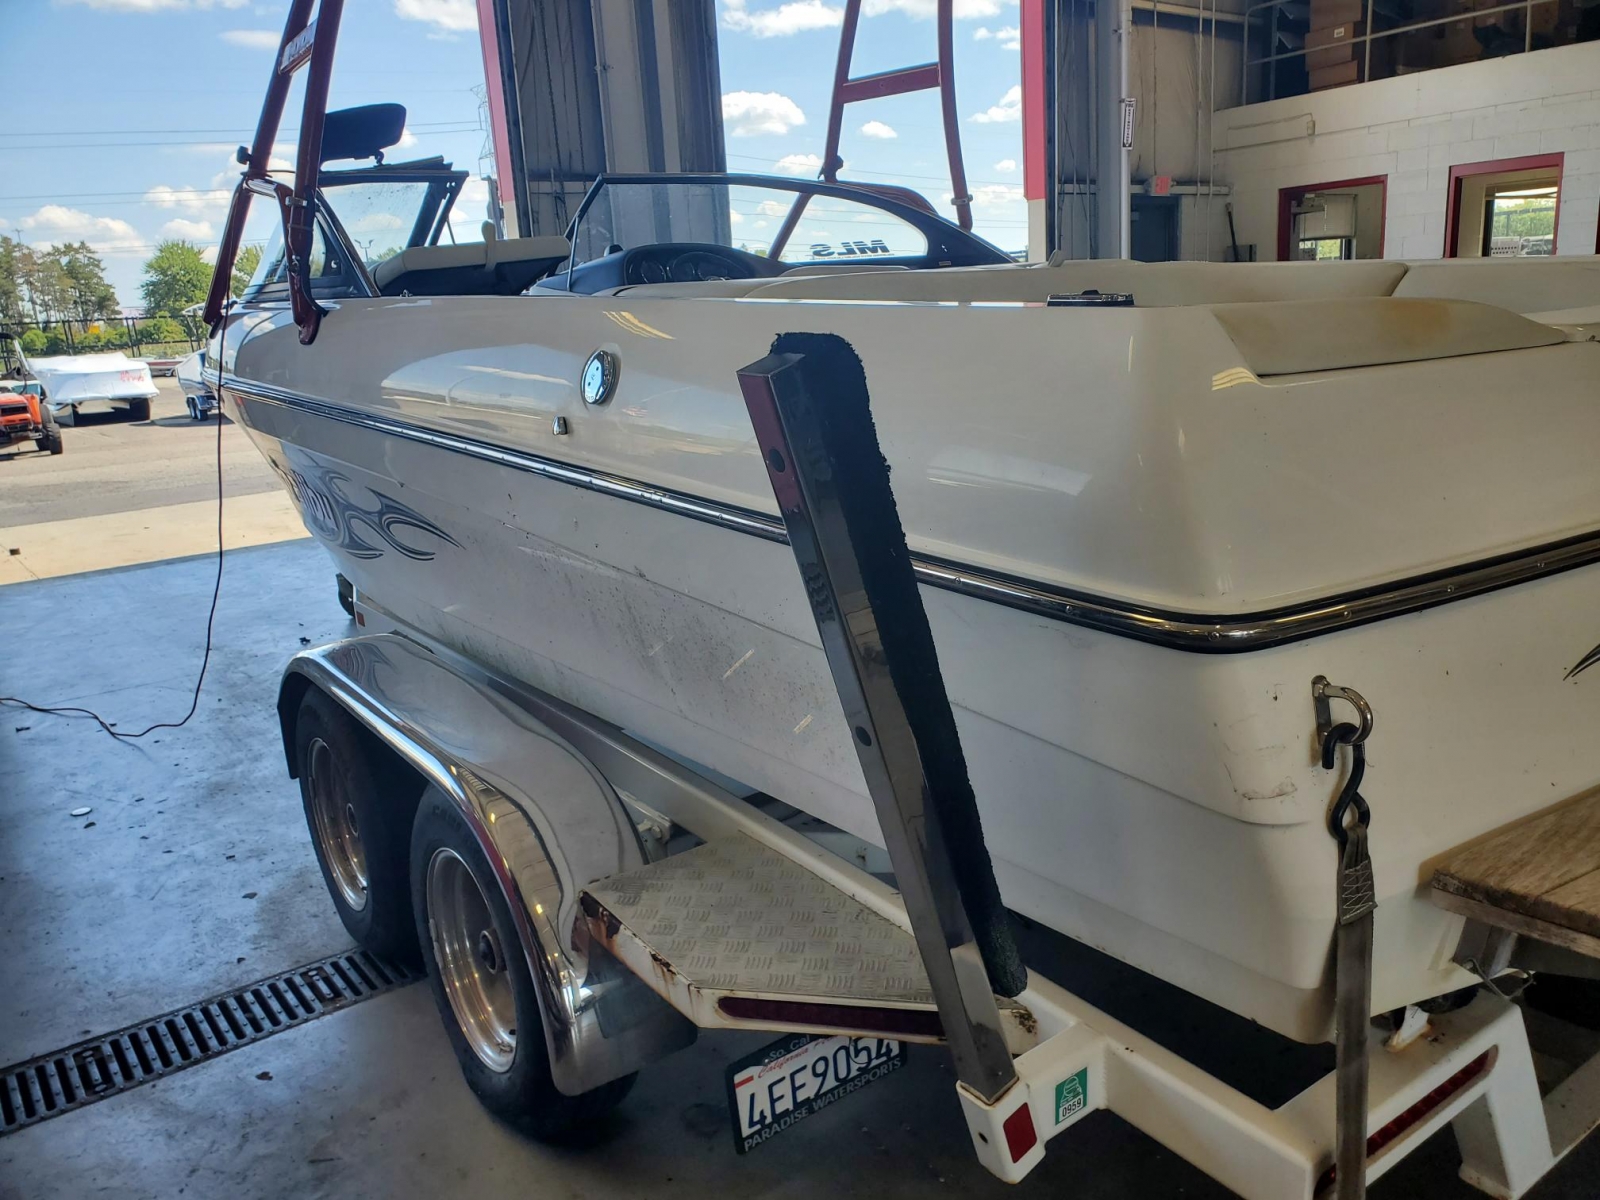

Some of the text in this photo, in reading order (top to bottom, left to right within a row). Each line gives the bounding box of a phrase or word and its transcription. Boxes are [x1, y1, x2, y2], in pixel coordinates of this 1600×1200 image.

[790, 1034, 811, 1050] Cal
[758, 1047, 809, 1078] California
[744, 1057, 902, 1152] PARADISE WATERSPORTS
[1062, 1097, 1082, 1118] 0959
